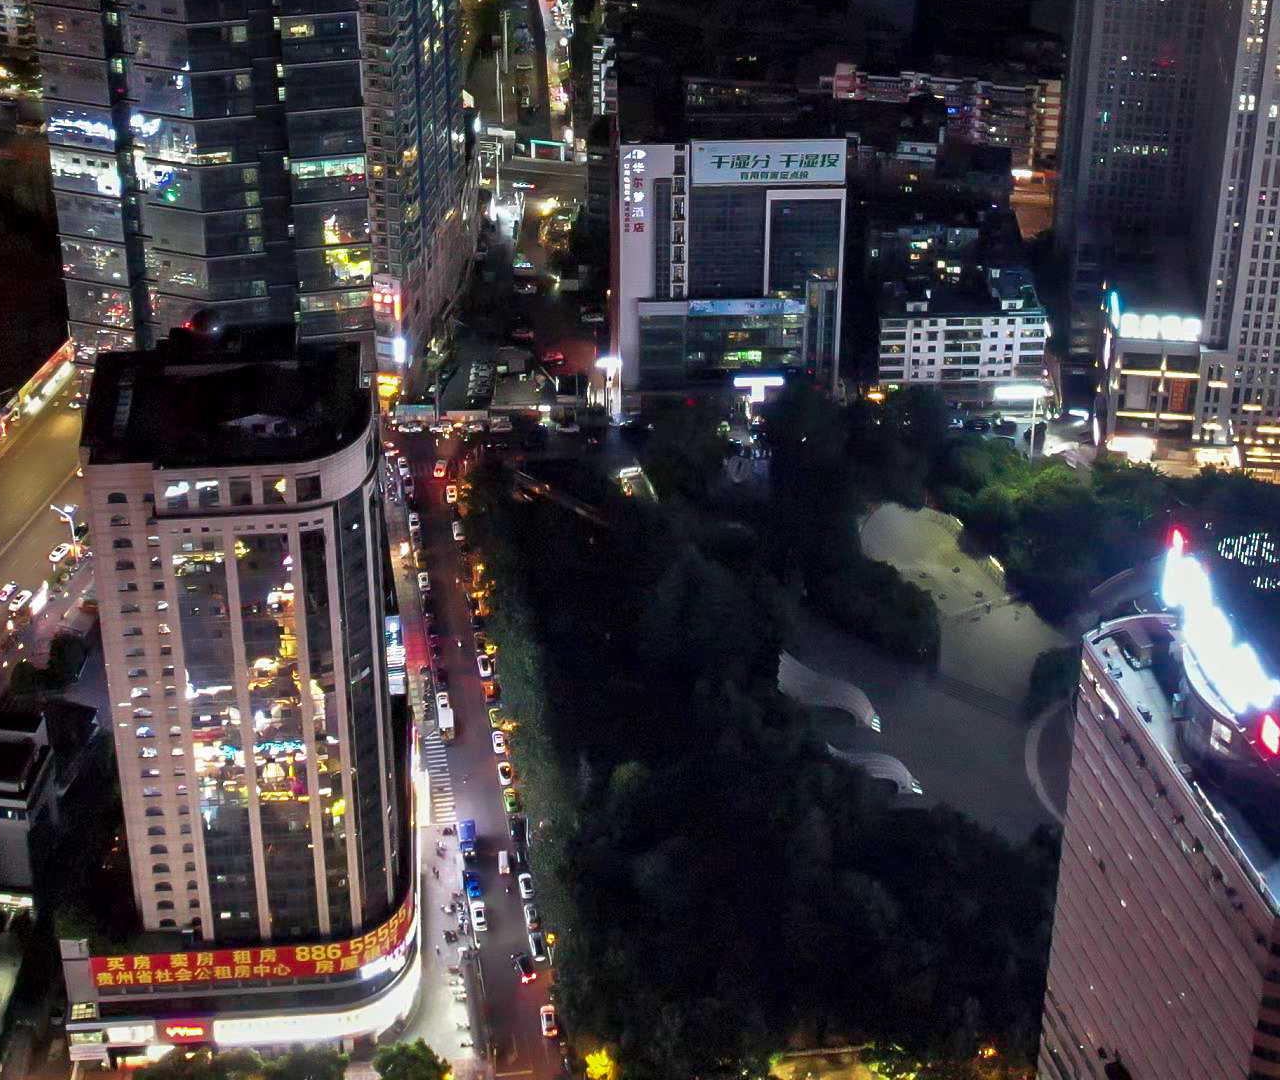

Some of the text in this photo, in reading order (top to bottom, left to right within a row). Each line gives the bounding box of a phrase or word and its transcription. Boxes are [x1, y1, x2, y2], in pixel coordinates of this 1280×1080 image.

[710, 153, 840, 169] 干湿分 干湿投
[106, 955, 151, 971] 买房
[232, 948, 277, 964] 租房
[295, 943, 342, 962] 886
[96, 963, 291, 987] 贵州省社会公租房中心
